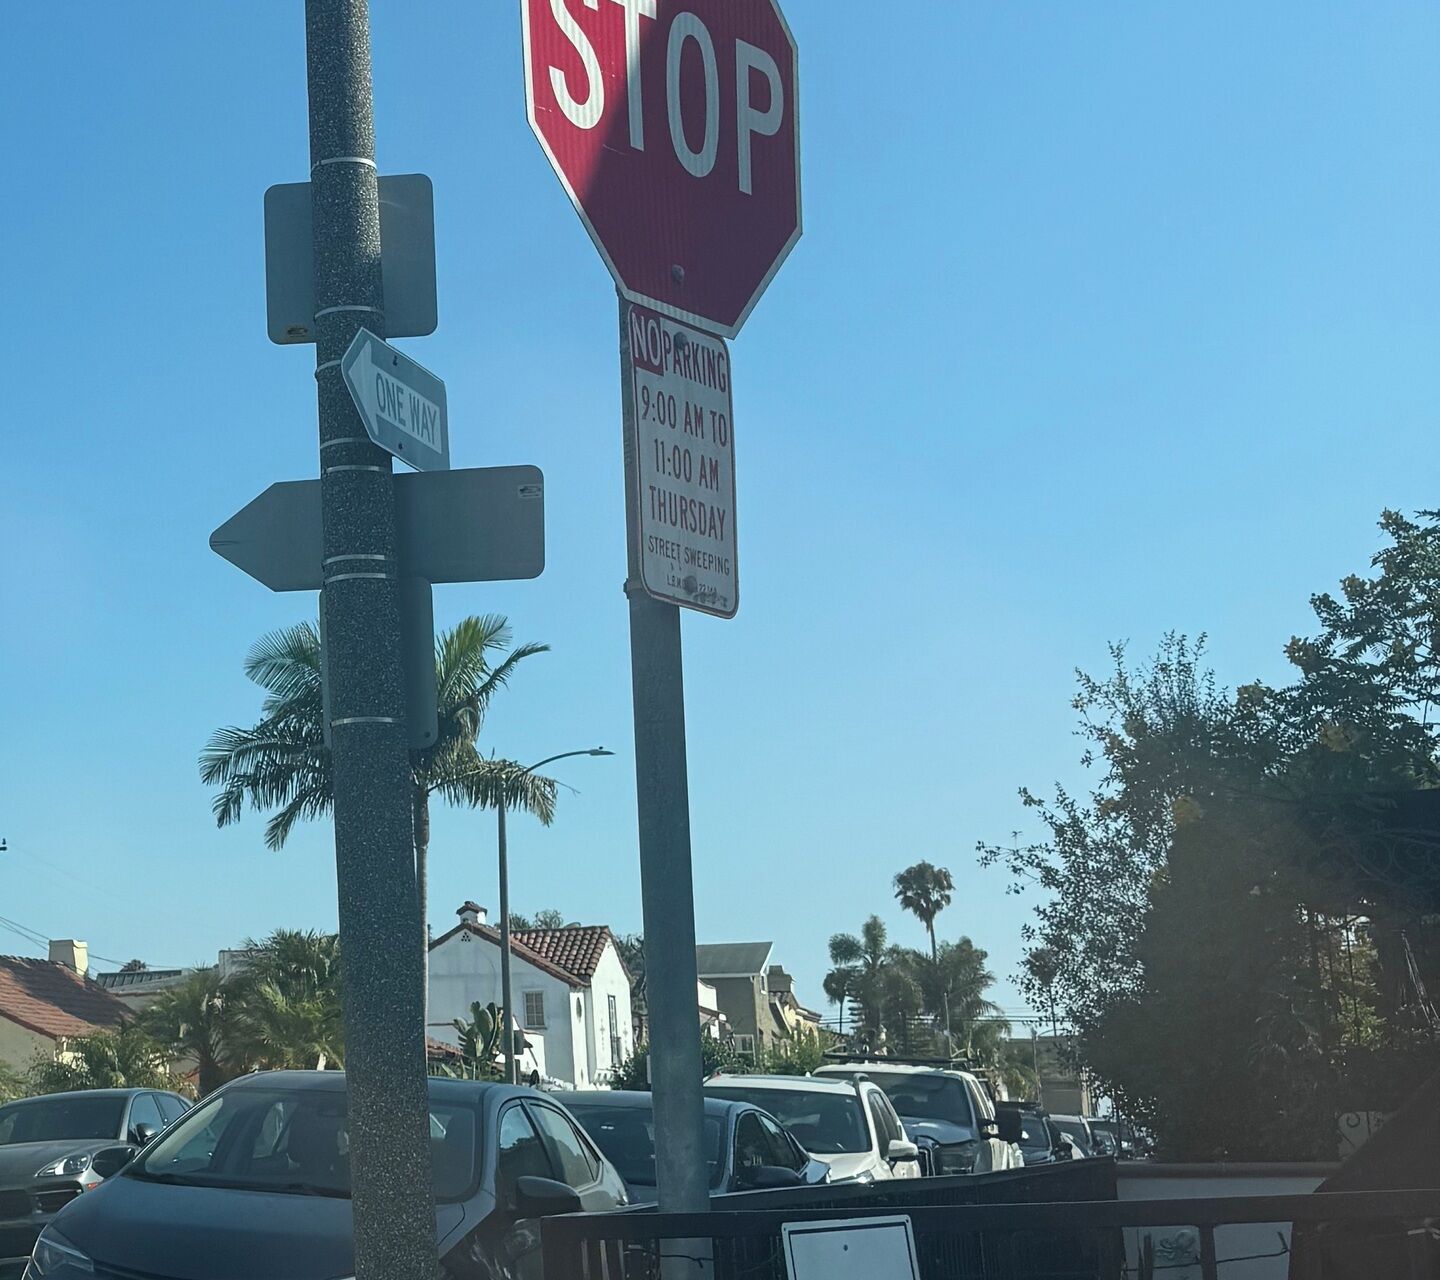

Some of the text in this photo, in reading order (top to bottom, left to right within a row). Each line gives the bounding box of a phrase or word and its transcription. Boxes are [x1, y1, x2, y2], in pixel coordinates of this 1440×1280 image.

[631, 312, 727, 393] NO PARKING
[376, 372, 440, 446] ONE WAY
[641, 385, 727, 447] 9:00 AM TO
[654, 438, 719, 492] 11:00 AM
[649, 485, 726, 541] THURSDAY
[648, 535, 730, 576] STREET SWEEPING
